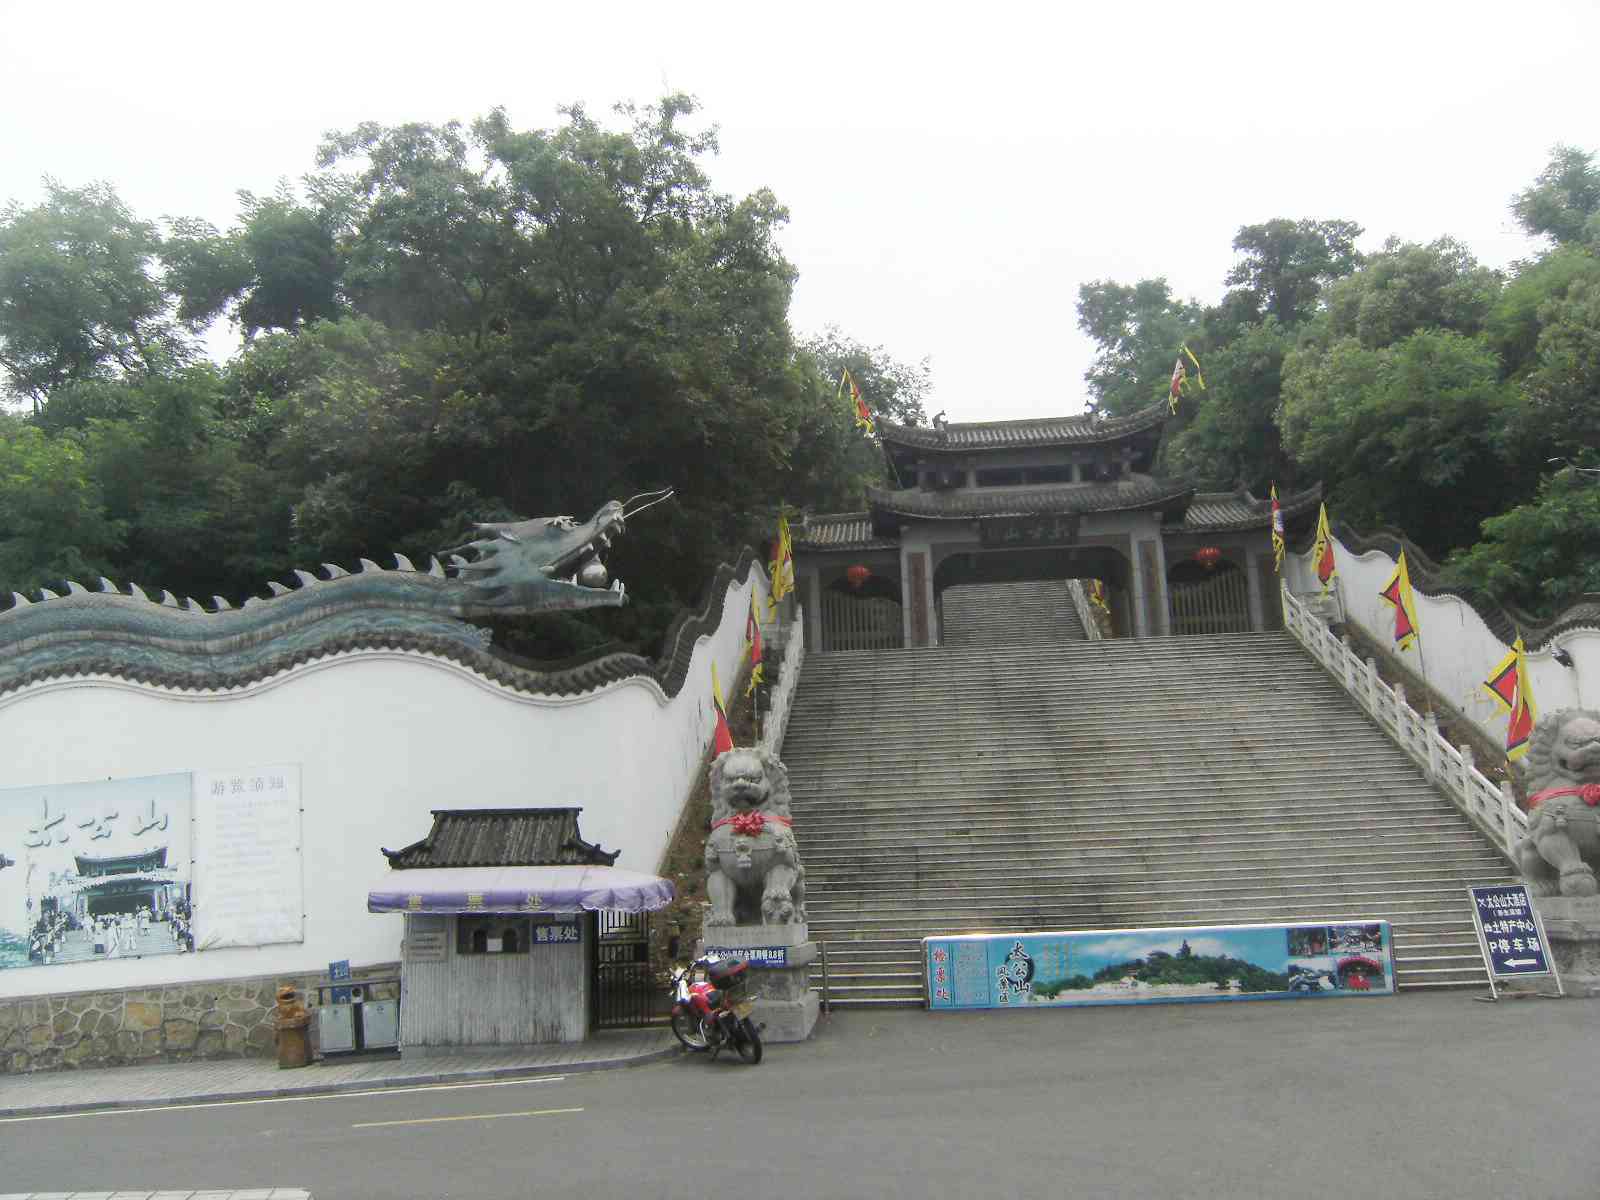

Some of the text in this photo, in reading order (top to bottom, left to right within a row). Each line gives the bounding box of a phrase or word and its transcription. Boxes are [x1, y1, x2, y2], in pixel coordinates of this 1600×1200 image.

[535, 925, 579, 942] 售票处
[1009, 940, 1033, 995] 太公山
